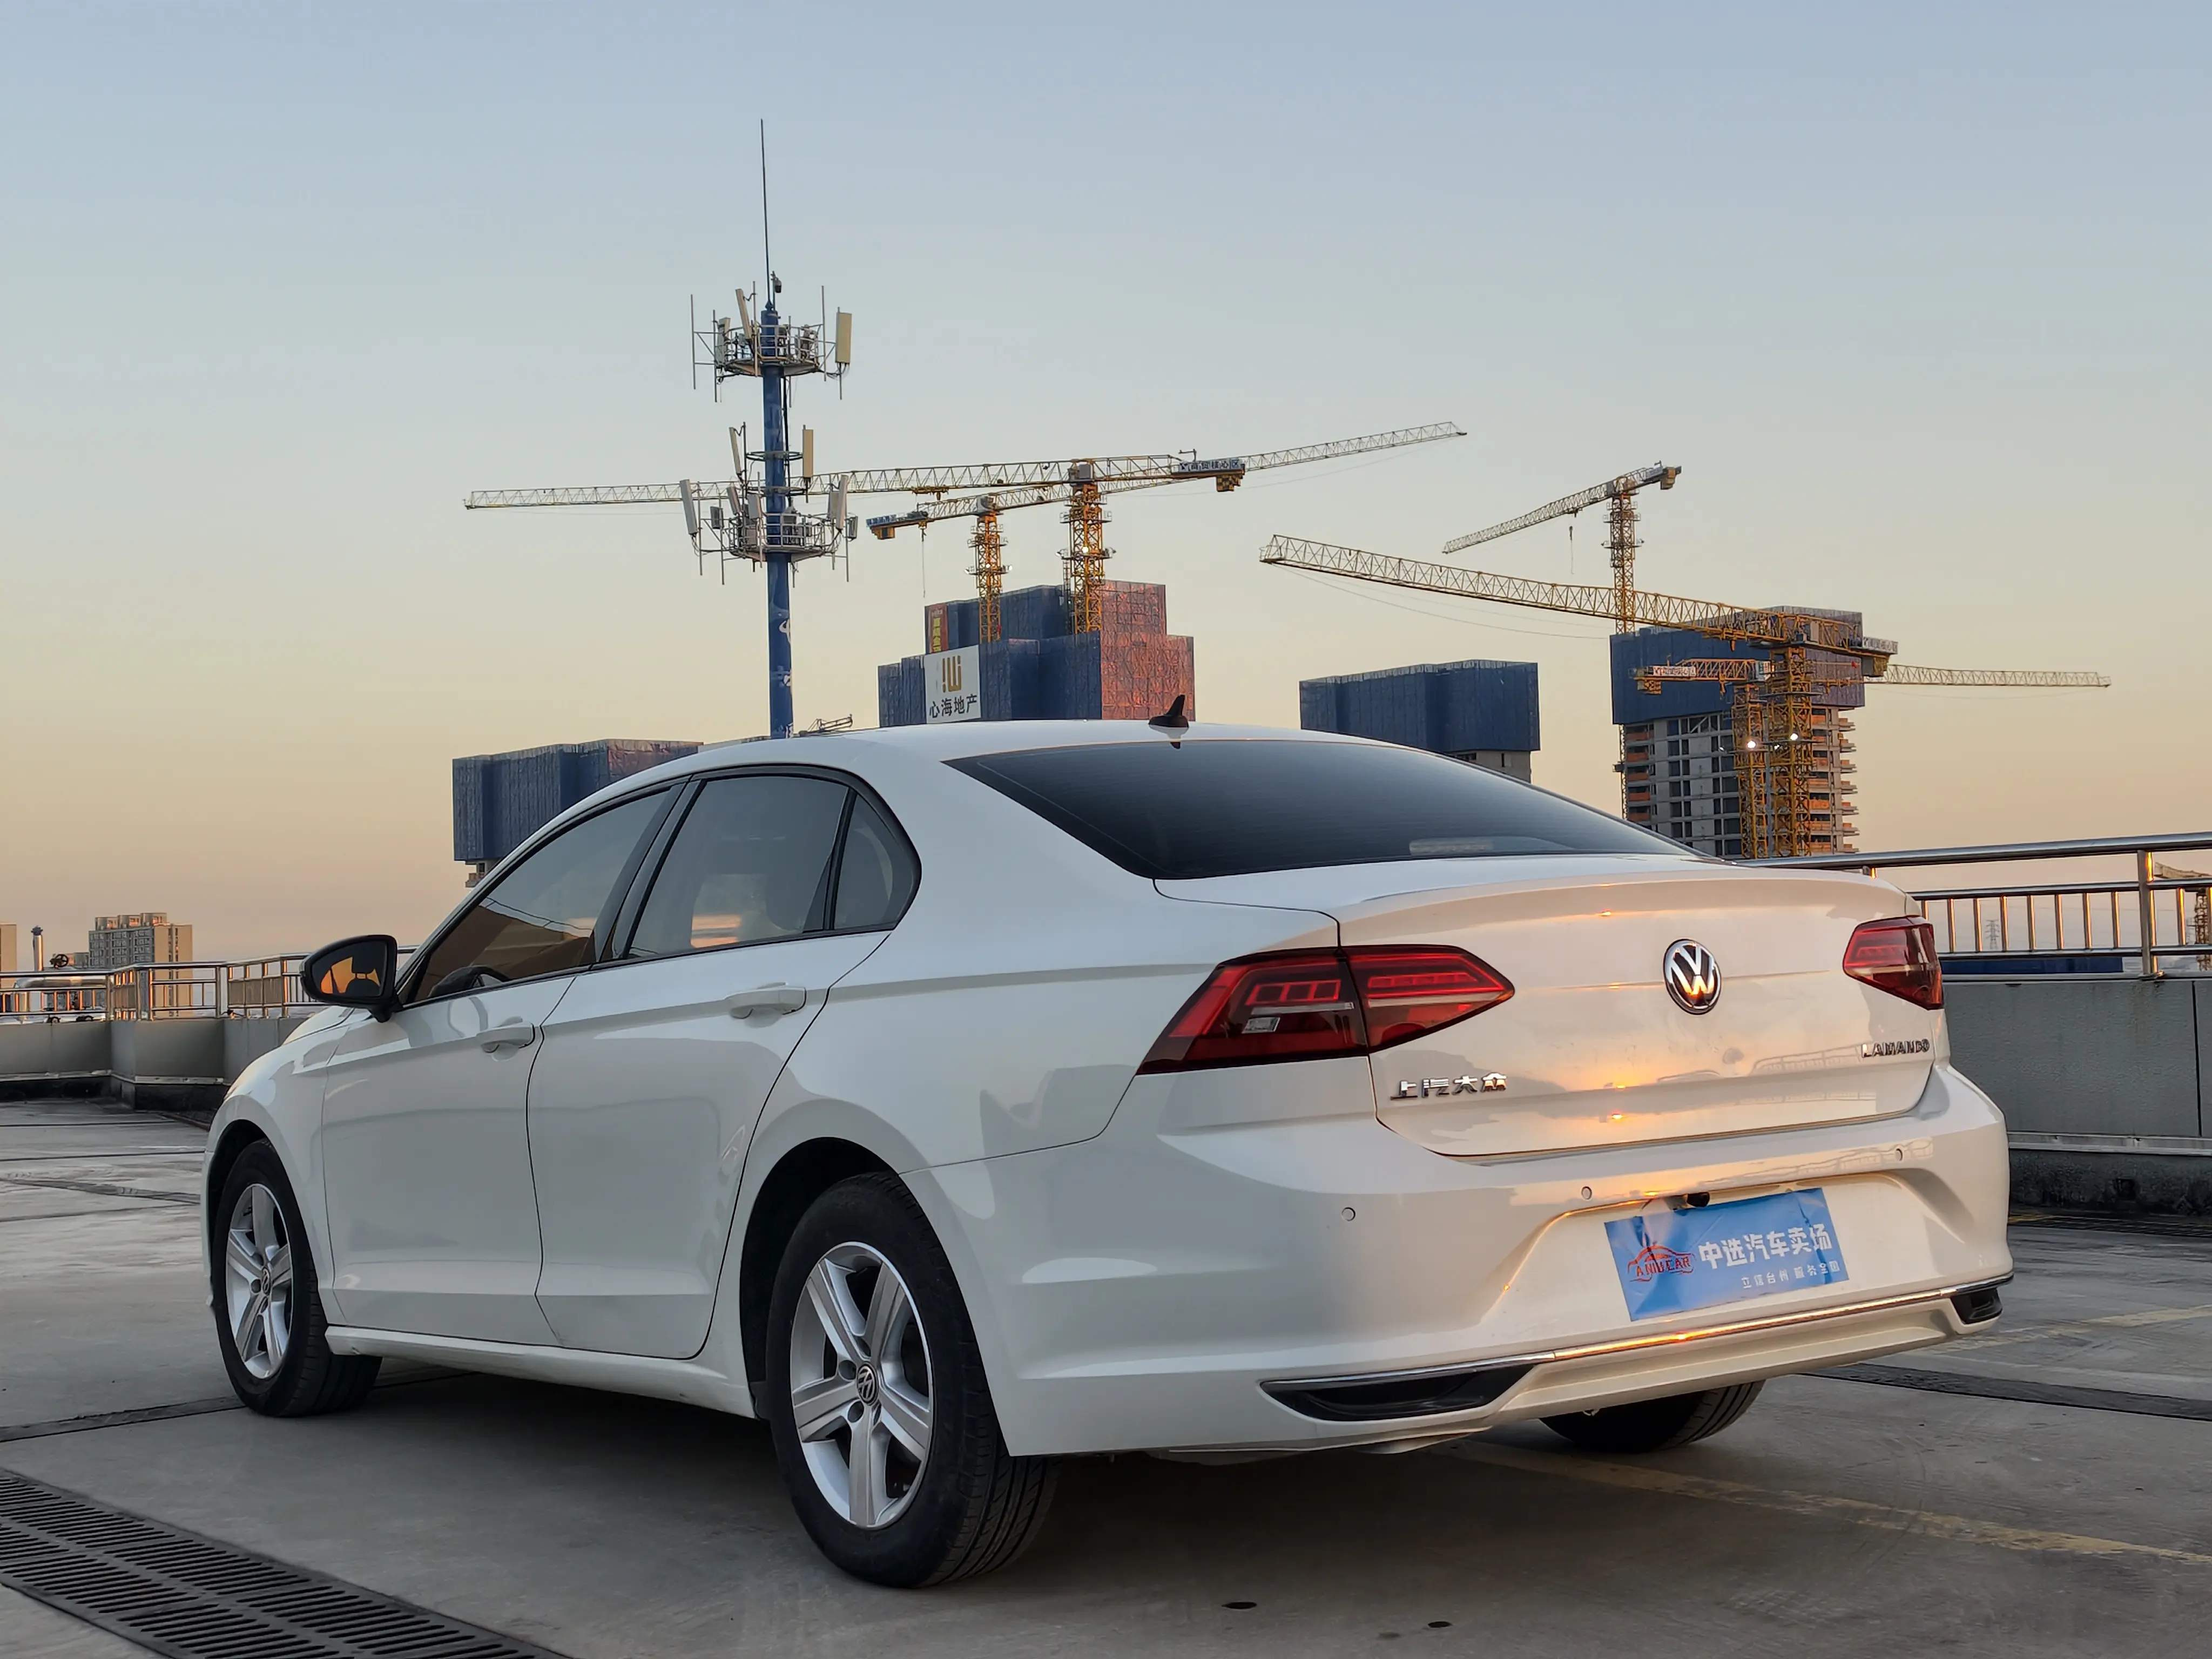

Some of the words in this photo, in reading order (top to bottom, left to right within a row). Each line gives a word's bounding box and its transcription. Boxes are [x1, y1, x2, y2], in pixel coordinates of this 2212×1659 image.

[929, 694, 977, 718] 心海地产
[1665, 939, 1721, 1014] VW
[1862, 1038, 1930, 1058] LAMANDO
[1390, 1072, 1507, 1100] 上汽大众
[1698, 1223, 1833, 1270] 中选汽车卖场
